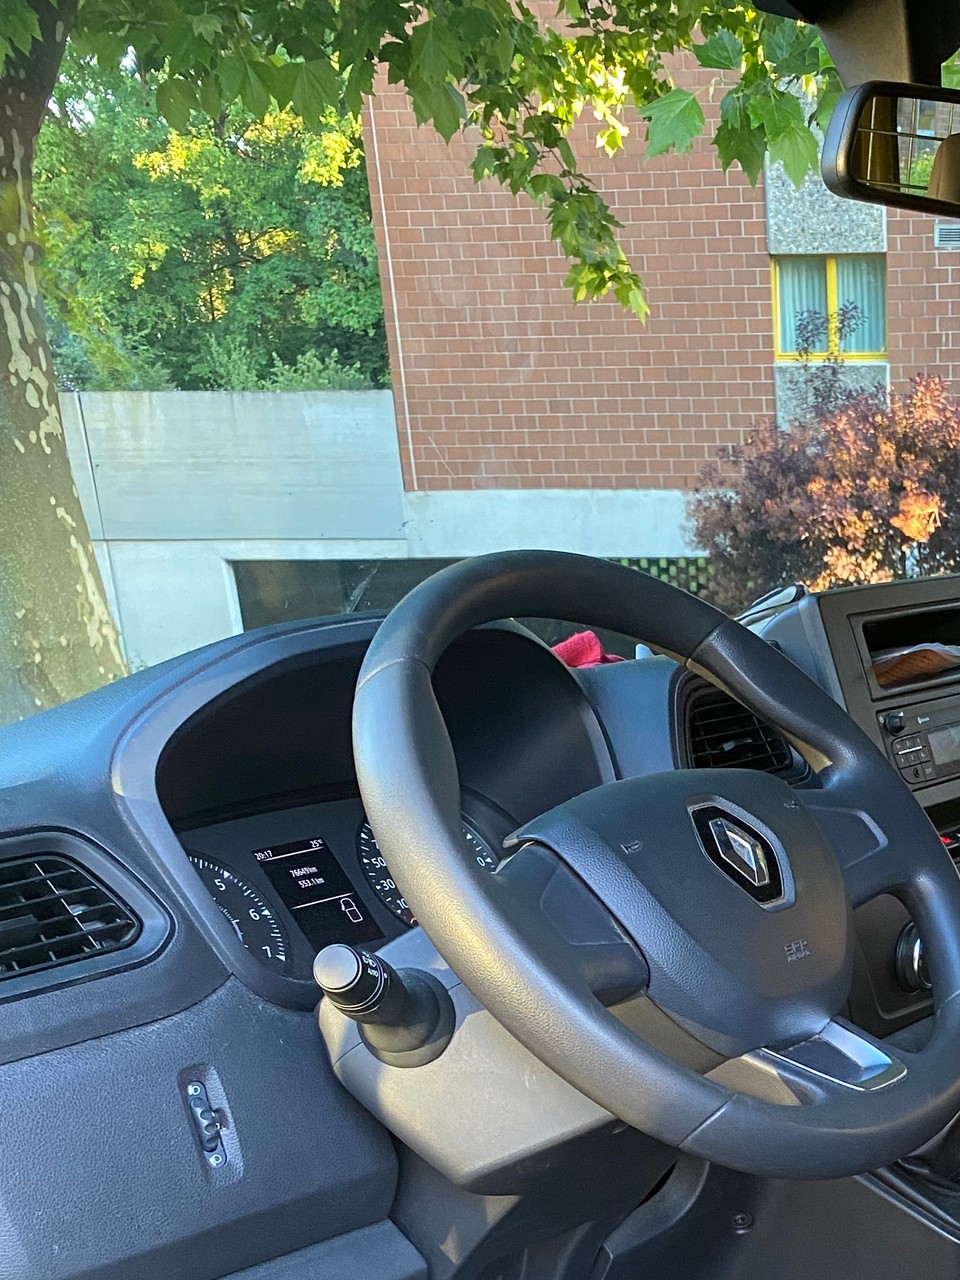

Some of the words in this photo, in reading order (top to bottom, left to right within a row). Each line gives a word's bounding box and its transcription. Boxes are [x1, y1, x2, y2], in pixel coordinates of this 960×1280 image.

[254, 850, 273, 861] 20:17
[371, 857, 386, 868] 50
[214, 879, 226, 891] 5
[380, 879, 395, 890] 30
[248, 908, 260, 921] 6
[262, 945, 272, 958] 7
